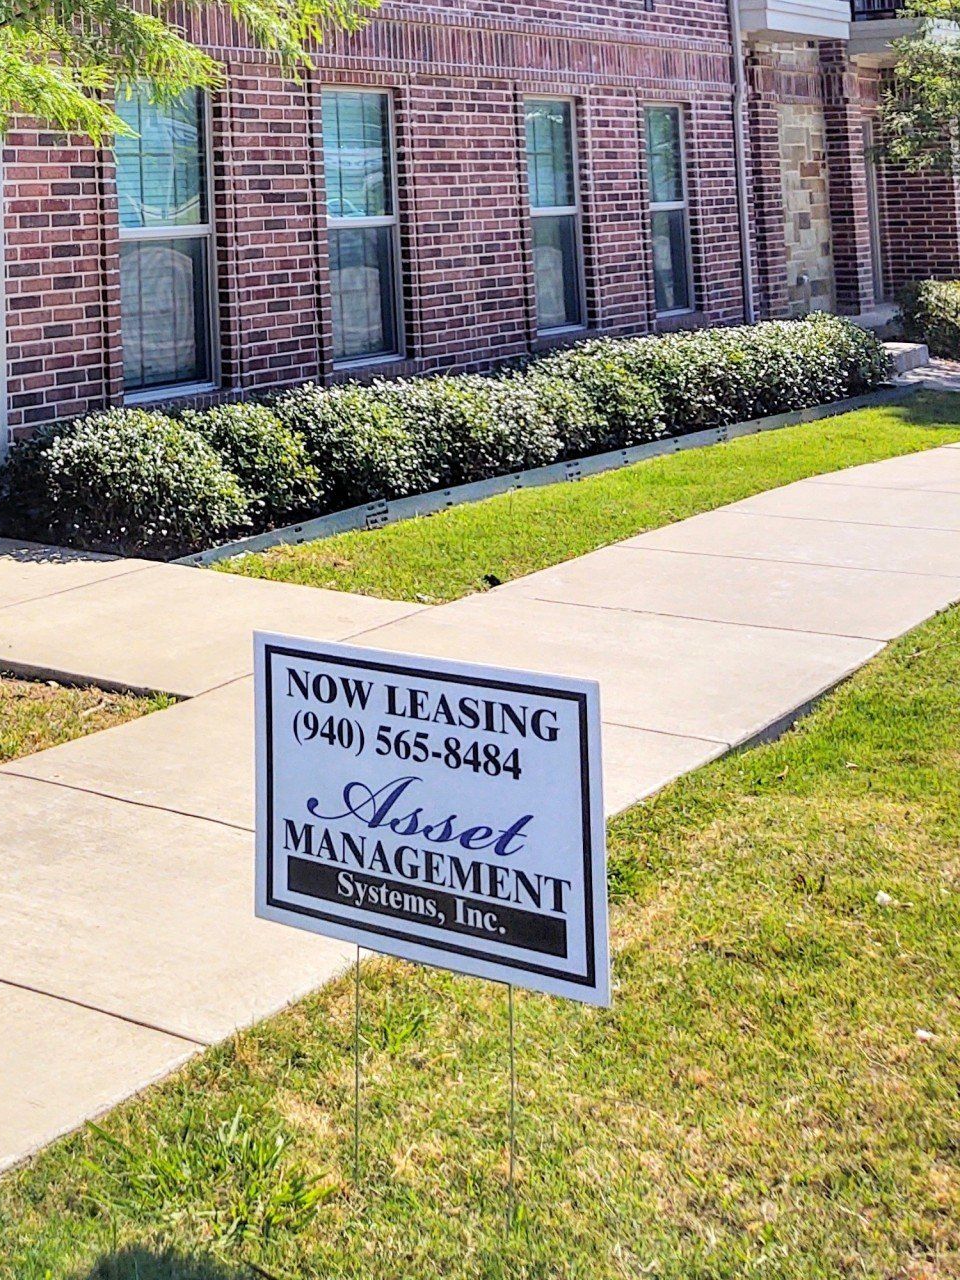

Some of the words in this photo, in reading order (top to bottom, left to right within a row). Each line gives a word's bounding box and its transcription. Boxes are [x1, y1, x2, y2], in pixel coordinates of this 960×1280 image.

[286, 667, 375, 711] NOW
[384, 684, 560, 742] LEASING
[292, 709, 365, 757] (940)
[375, 726, 522, 780] 565-8484
[306, 775, 535, 857] Asset
[283, 818, 571, 914] MANAGEMENT
[337, 871, 446, 926] Systems,
[454, 897, 507, 935] Inc.
